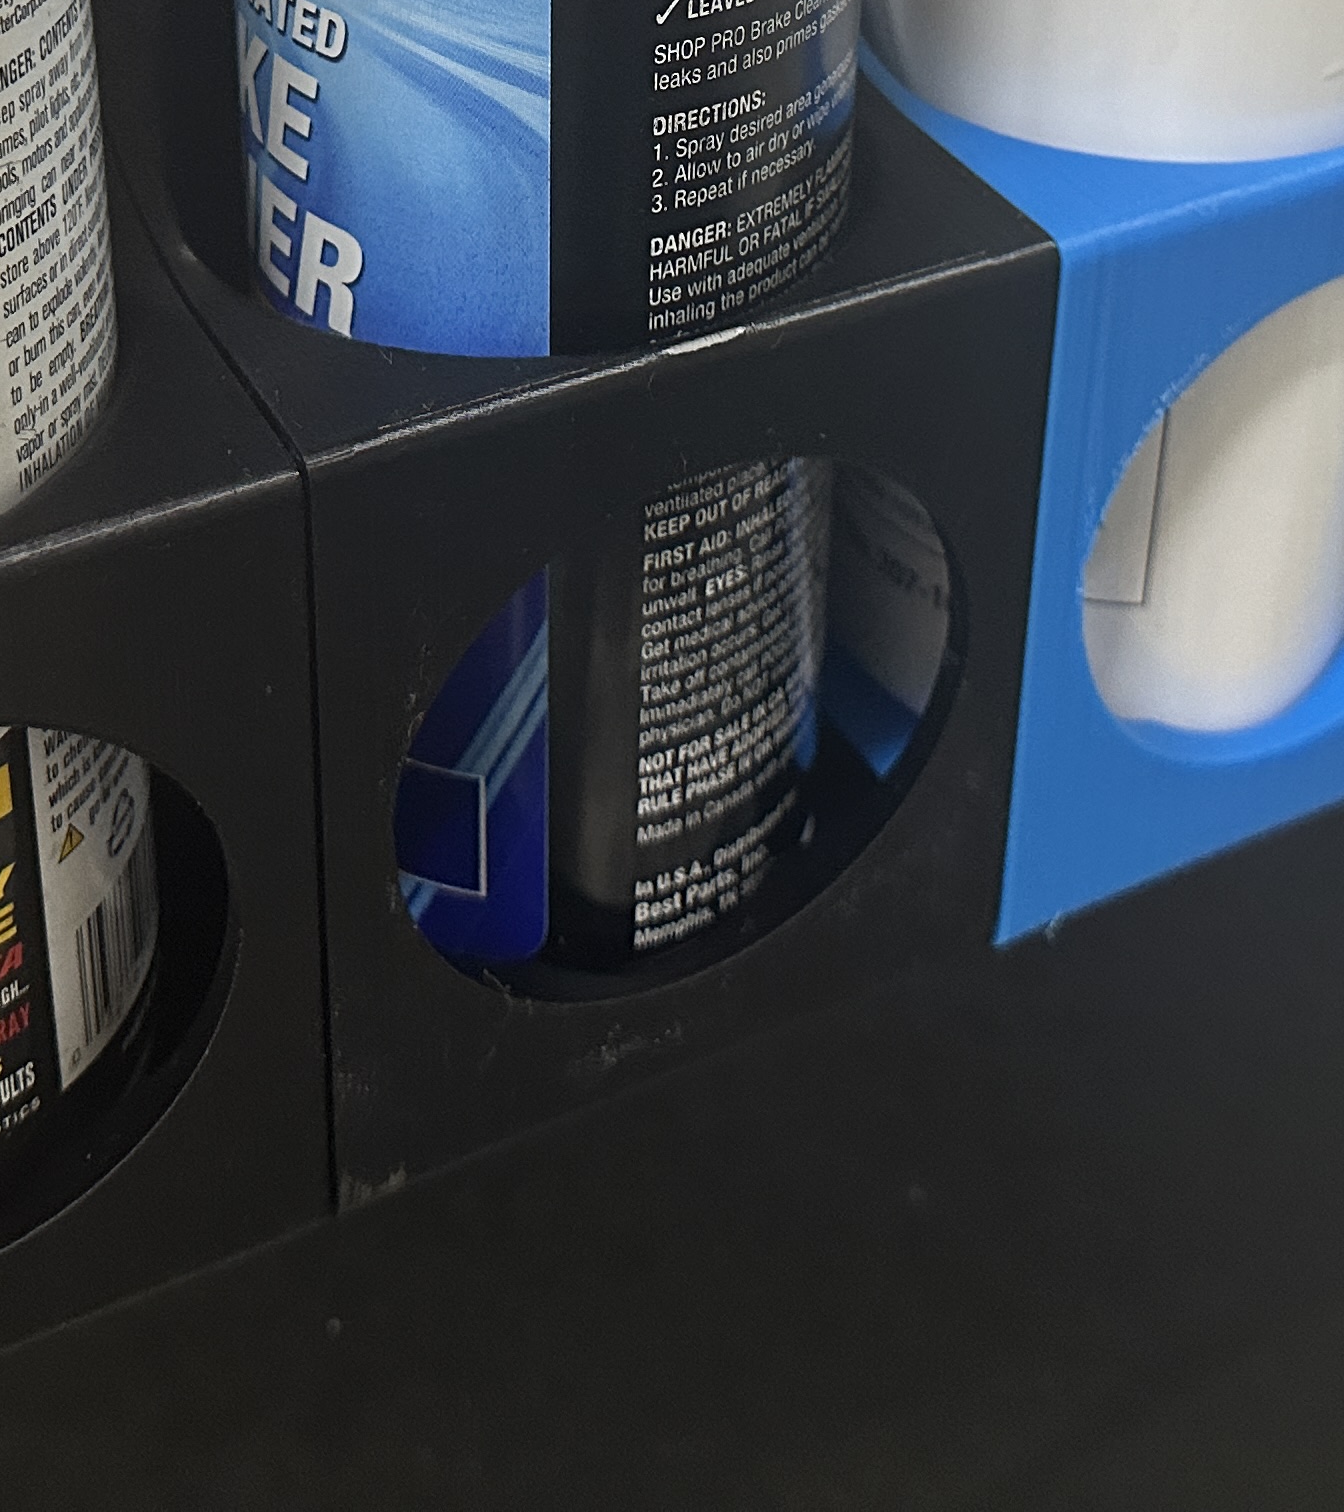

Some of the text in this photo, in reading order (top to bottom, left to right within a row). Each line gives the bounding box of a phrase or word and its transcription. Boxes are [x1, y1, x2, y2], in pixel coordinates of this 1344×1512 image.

[653, 10, 792, 66] SHOP PRO Brake
[653, 44, 773, 92] leaks and also
[28, 103, 50, 143] pilot
[652, 89, 767, 137] DIRECTIONS:
[675, 103, 783, 160] Spray desired
[674, 141, 766, 185] Allow to air
[674, 175, 734, 209] Repeat
[0, 254, 30, 289] store
[32, 228, 61, 266] above
[649, 219, 733, 257] DANGER:
[649, 231, 760, 282] HARMFUL OR
[2, 271, 49, 320] surfaces
[647, 288, 745, 332] inhaling the
[648, 272, 723, 308] Use with
[8, 354, 21, 378] or
[10, 369, 43, 406] to be
[643, 487, 752, 541] KEEP OUT OF
[643, 541, 695, 573] FIRST
[641, 606, 703, 640] contact
